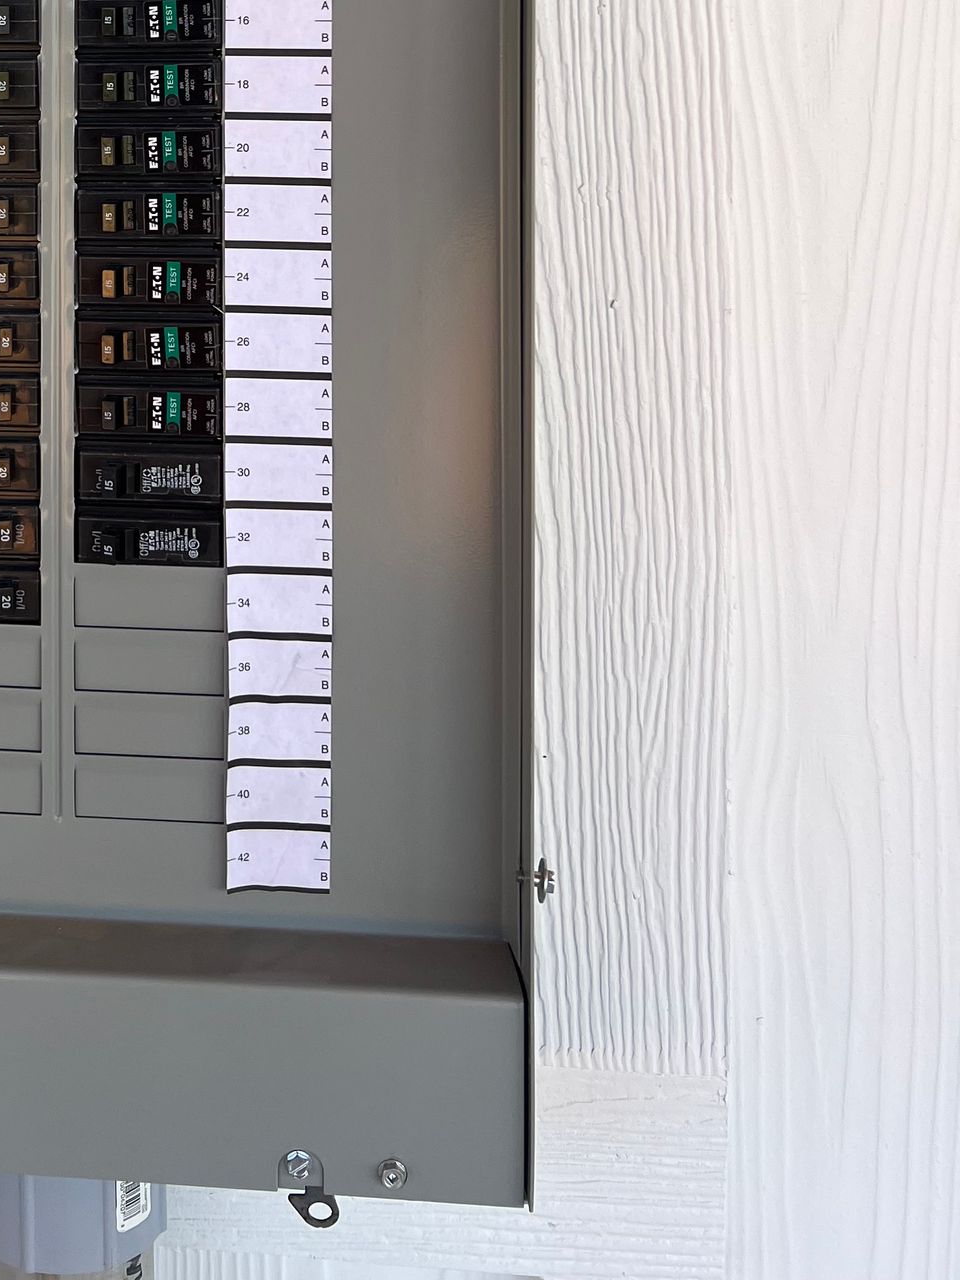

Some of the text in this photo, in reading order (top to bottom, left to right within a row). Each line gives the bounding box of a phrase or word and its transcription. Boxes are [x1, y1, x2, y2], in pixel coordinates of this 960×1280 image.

[238, 16, 249, 25] 16
[238, 80, 249, 89] 18
[237, 144, 249, 152] 20
[237, 273, 249, 281] 24
[238, 403, 250, 411] 28
[238, 468, 250, 477] 30
[105, 480, 113, 490] 15
[0, 529, 10, 541] 20
[238, 533, 250, 541] 32
[104, 545, 113, 555] 15
[2, 595, 11, 608] 20
[239, 662, 250, 671] 36
[237, 726, 250, 735] 38
[238, 853, 249, 861] 42
